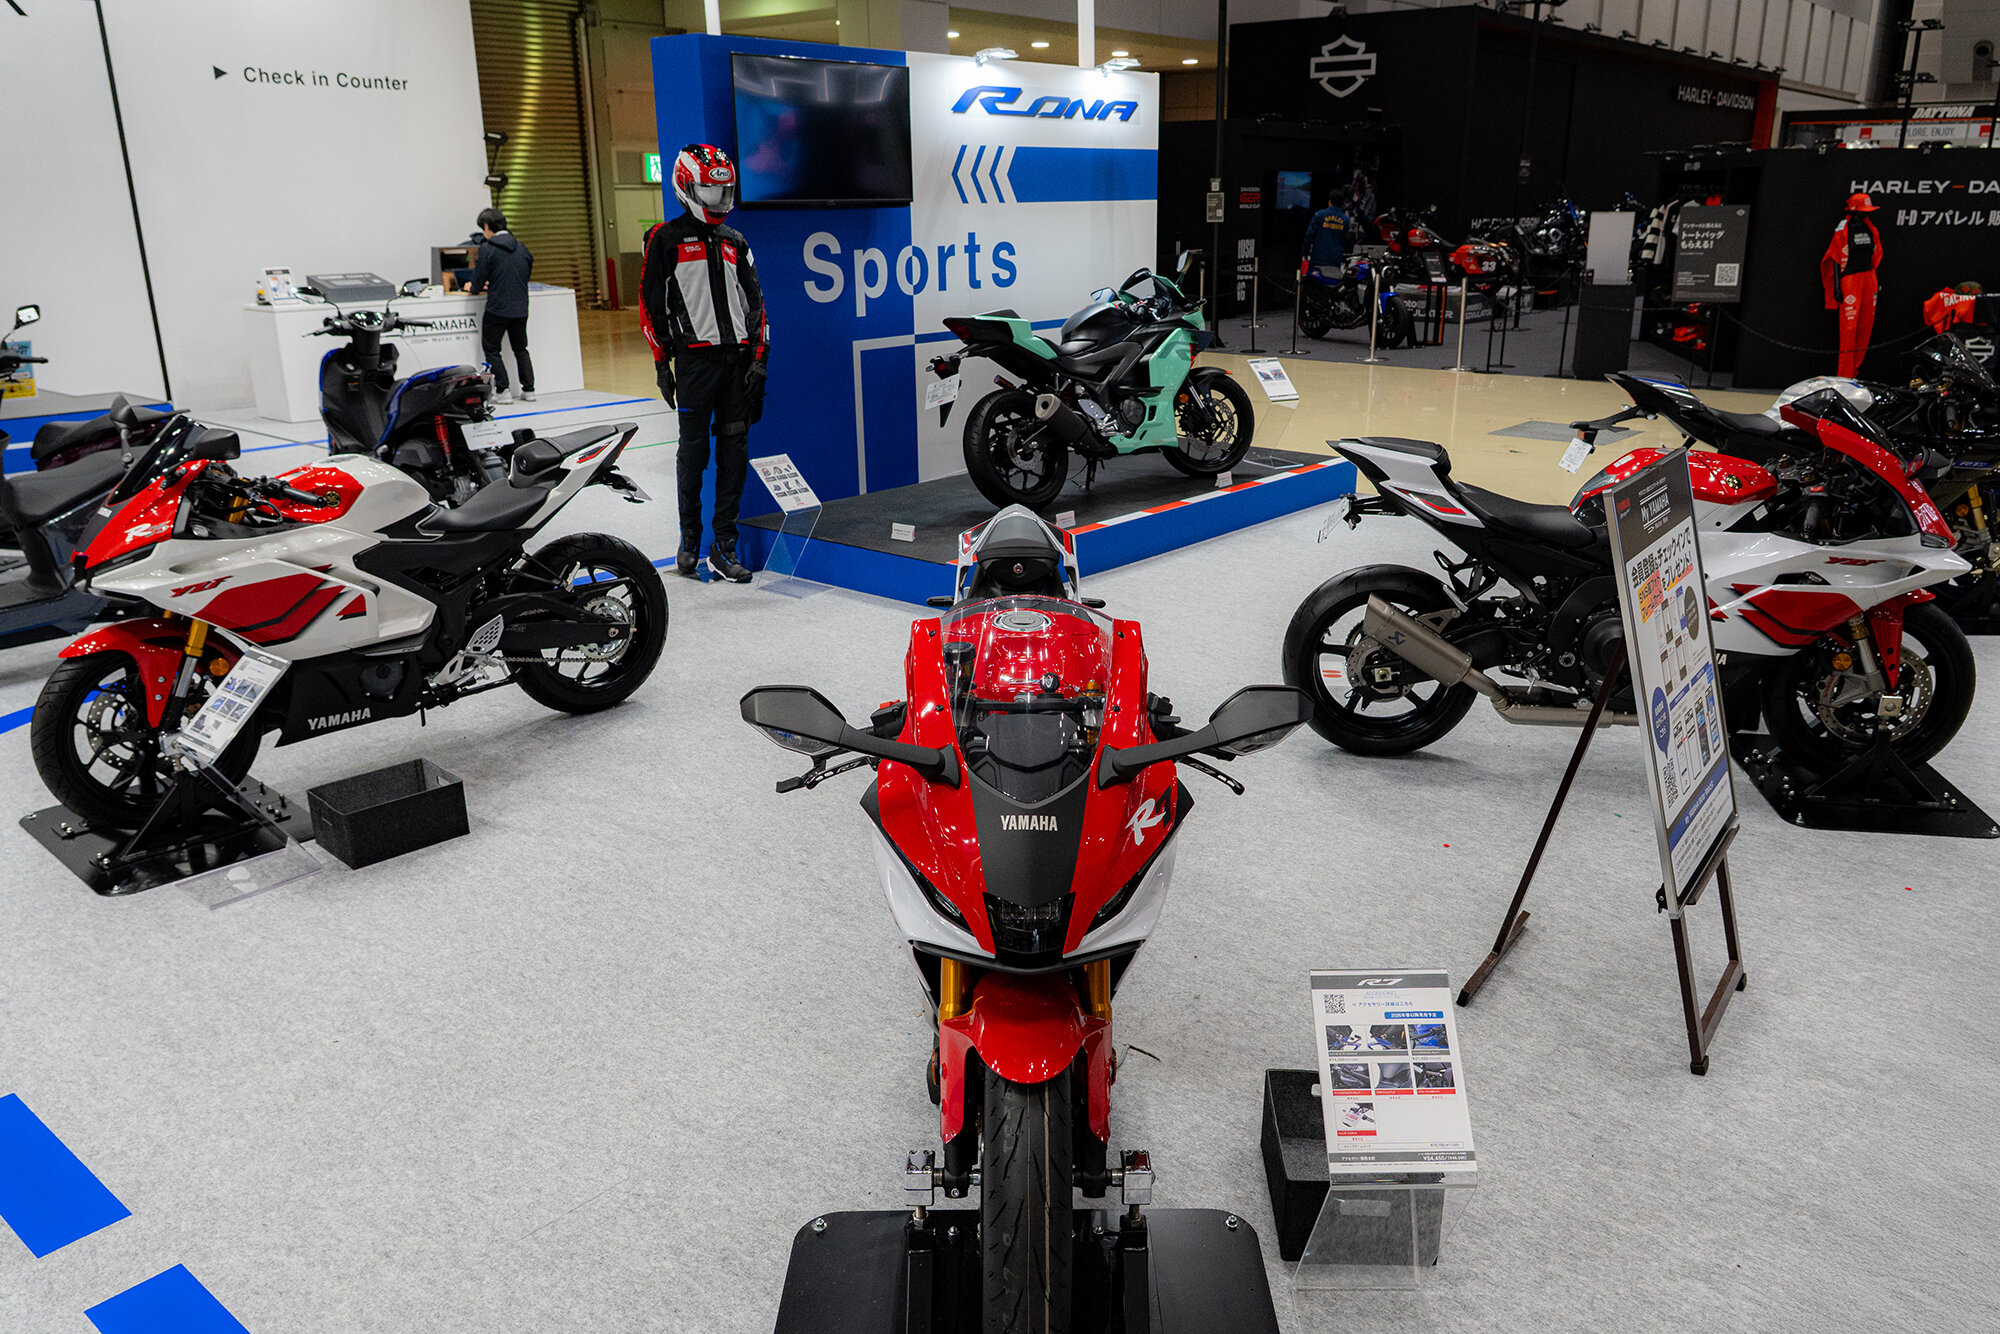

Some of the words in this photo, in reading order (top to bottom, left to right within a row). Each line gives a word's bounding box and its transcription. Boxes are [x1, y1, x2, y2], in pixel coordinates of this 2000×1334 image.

[243, 66, 305, 85] Check
[311, 70, 330, 87] in
[336, 72, 408, 91] Counter
[1912, 106, 1976, 119] DAYTONA
[709, 168, 731, 177] Arai
[1920, 209, 1984, 226] アパレル
[1681, 230, 1725, 240] トートバッグ
[1481, 260, 1497, 272] 33
[803, 231, 1018, 318] Sports
[124, 520, 172, 543] R25
[307, 707, 372, 731] YAMAHA
[1000, 815, 1058, 831] YAMAHA
[1357, 978, 1403, 986] R7
